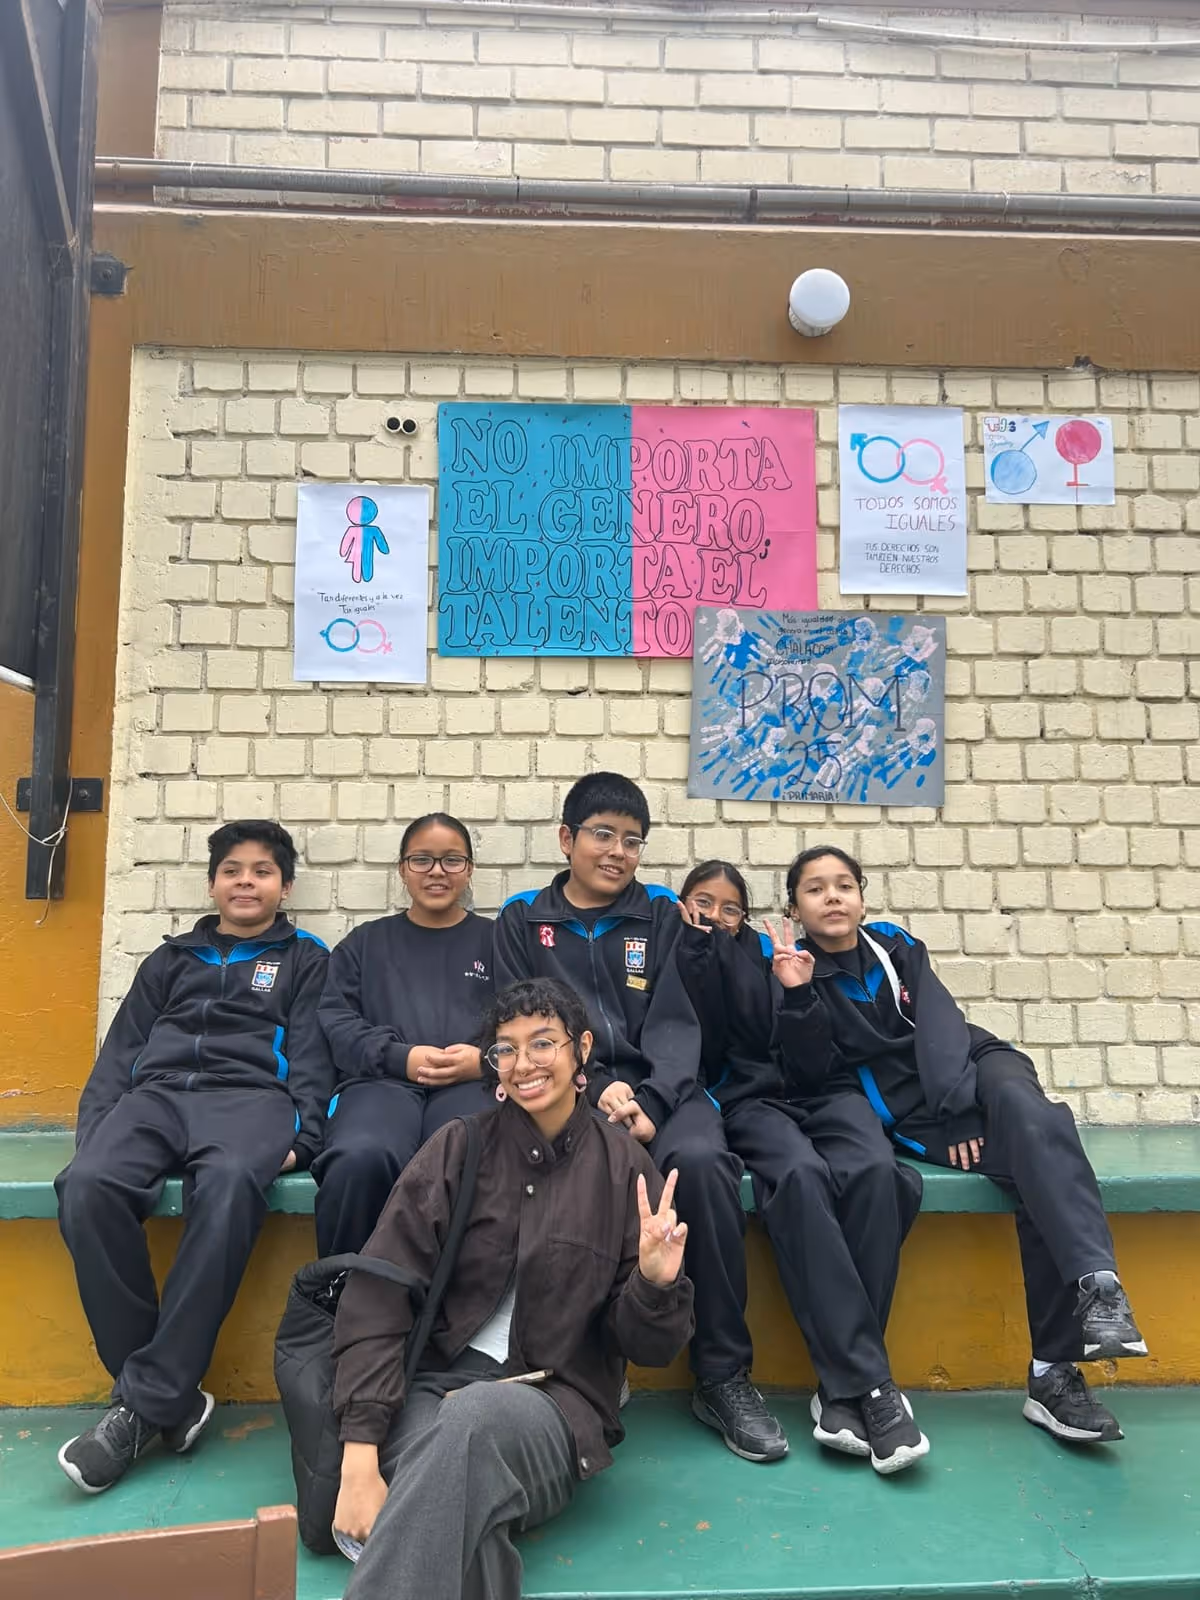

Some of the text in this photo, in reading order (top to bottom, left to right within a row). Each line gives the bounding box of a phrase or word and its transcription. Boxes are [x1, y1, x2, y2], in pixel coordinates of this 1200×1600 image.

[451, 418, 792, 491] NO IMPORTA
[452, 479, 527, 534] EL
[854, 496, 959, 511] TODOS SOMOS
[884, 513, 956, 531] IGUALES
[864, 542, 939, 553] TUS DERECHOS SON
[879, 562, 921, 574] DERECHOS
[901, 553, 939, 563] NUESTROS
[446, 536, 767, 608] IMPORTA EL
[438, 592, 692, 656] TALENTO
[737, 671, 906, 732] PROM
[786, 741, 842, 788] 25
